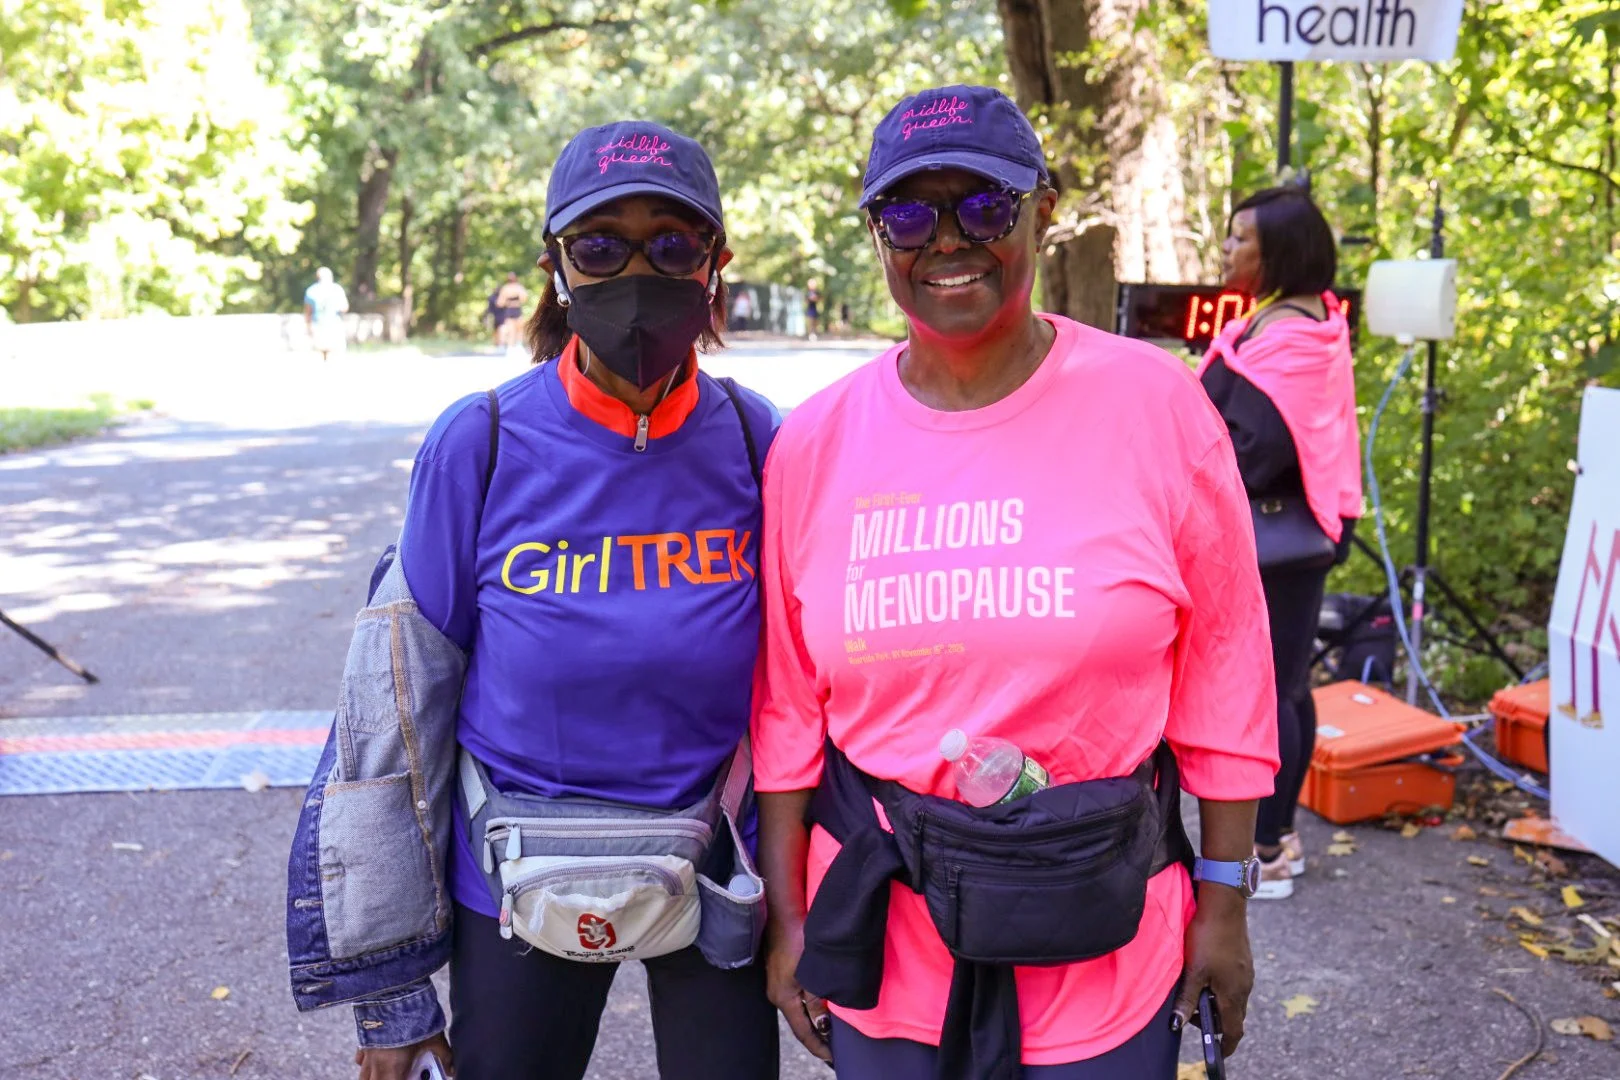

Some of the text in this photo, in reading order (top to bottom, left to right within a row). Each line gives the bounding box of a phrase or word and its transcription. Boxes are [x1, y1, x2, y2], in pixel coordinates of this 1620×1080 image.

[1257, 0, 1416, 47] health
[900, 96, 969, 121] midlife
[849, 498, 1024, 562] MILLIONS
[846, 562, 865, 583] for
[844, 566, 1075, 634] MENOPAUSE
[845, 637, 867, 653] Walk
